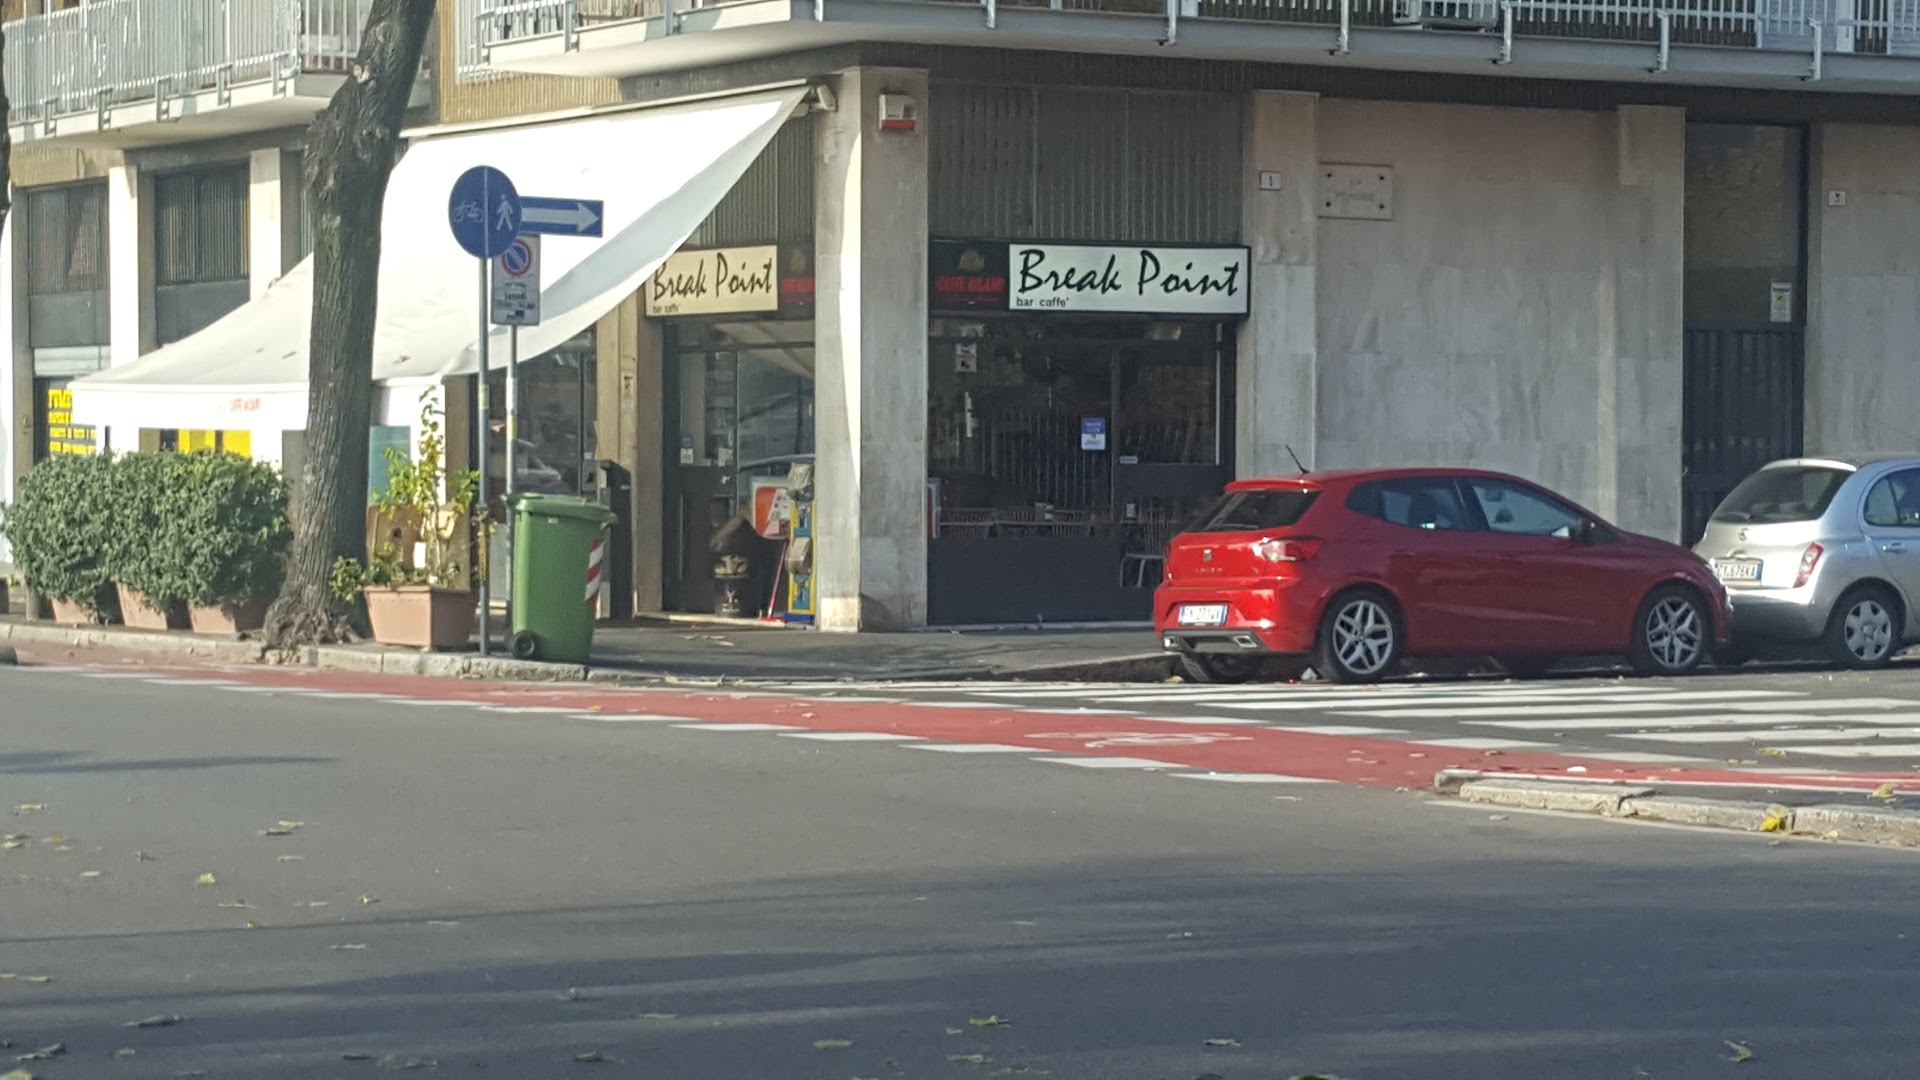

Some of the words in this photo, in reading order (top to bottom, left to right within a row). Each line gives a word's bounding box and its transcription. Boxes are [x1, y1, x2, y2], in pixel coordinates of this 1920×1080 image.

[653, 259, 707, 301] Break
[715, 252, 773, 298] Point
[1017, 249, 1122, 294] Break
[1137, 249, 1240, 297] Point
[1016, 296, 1034, 307] bar
